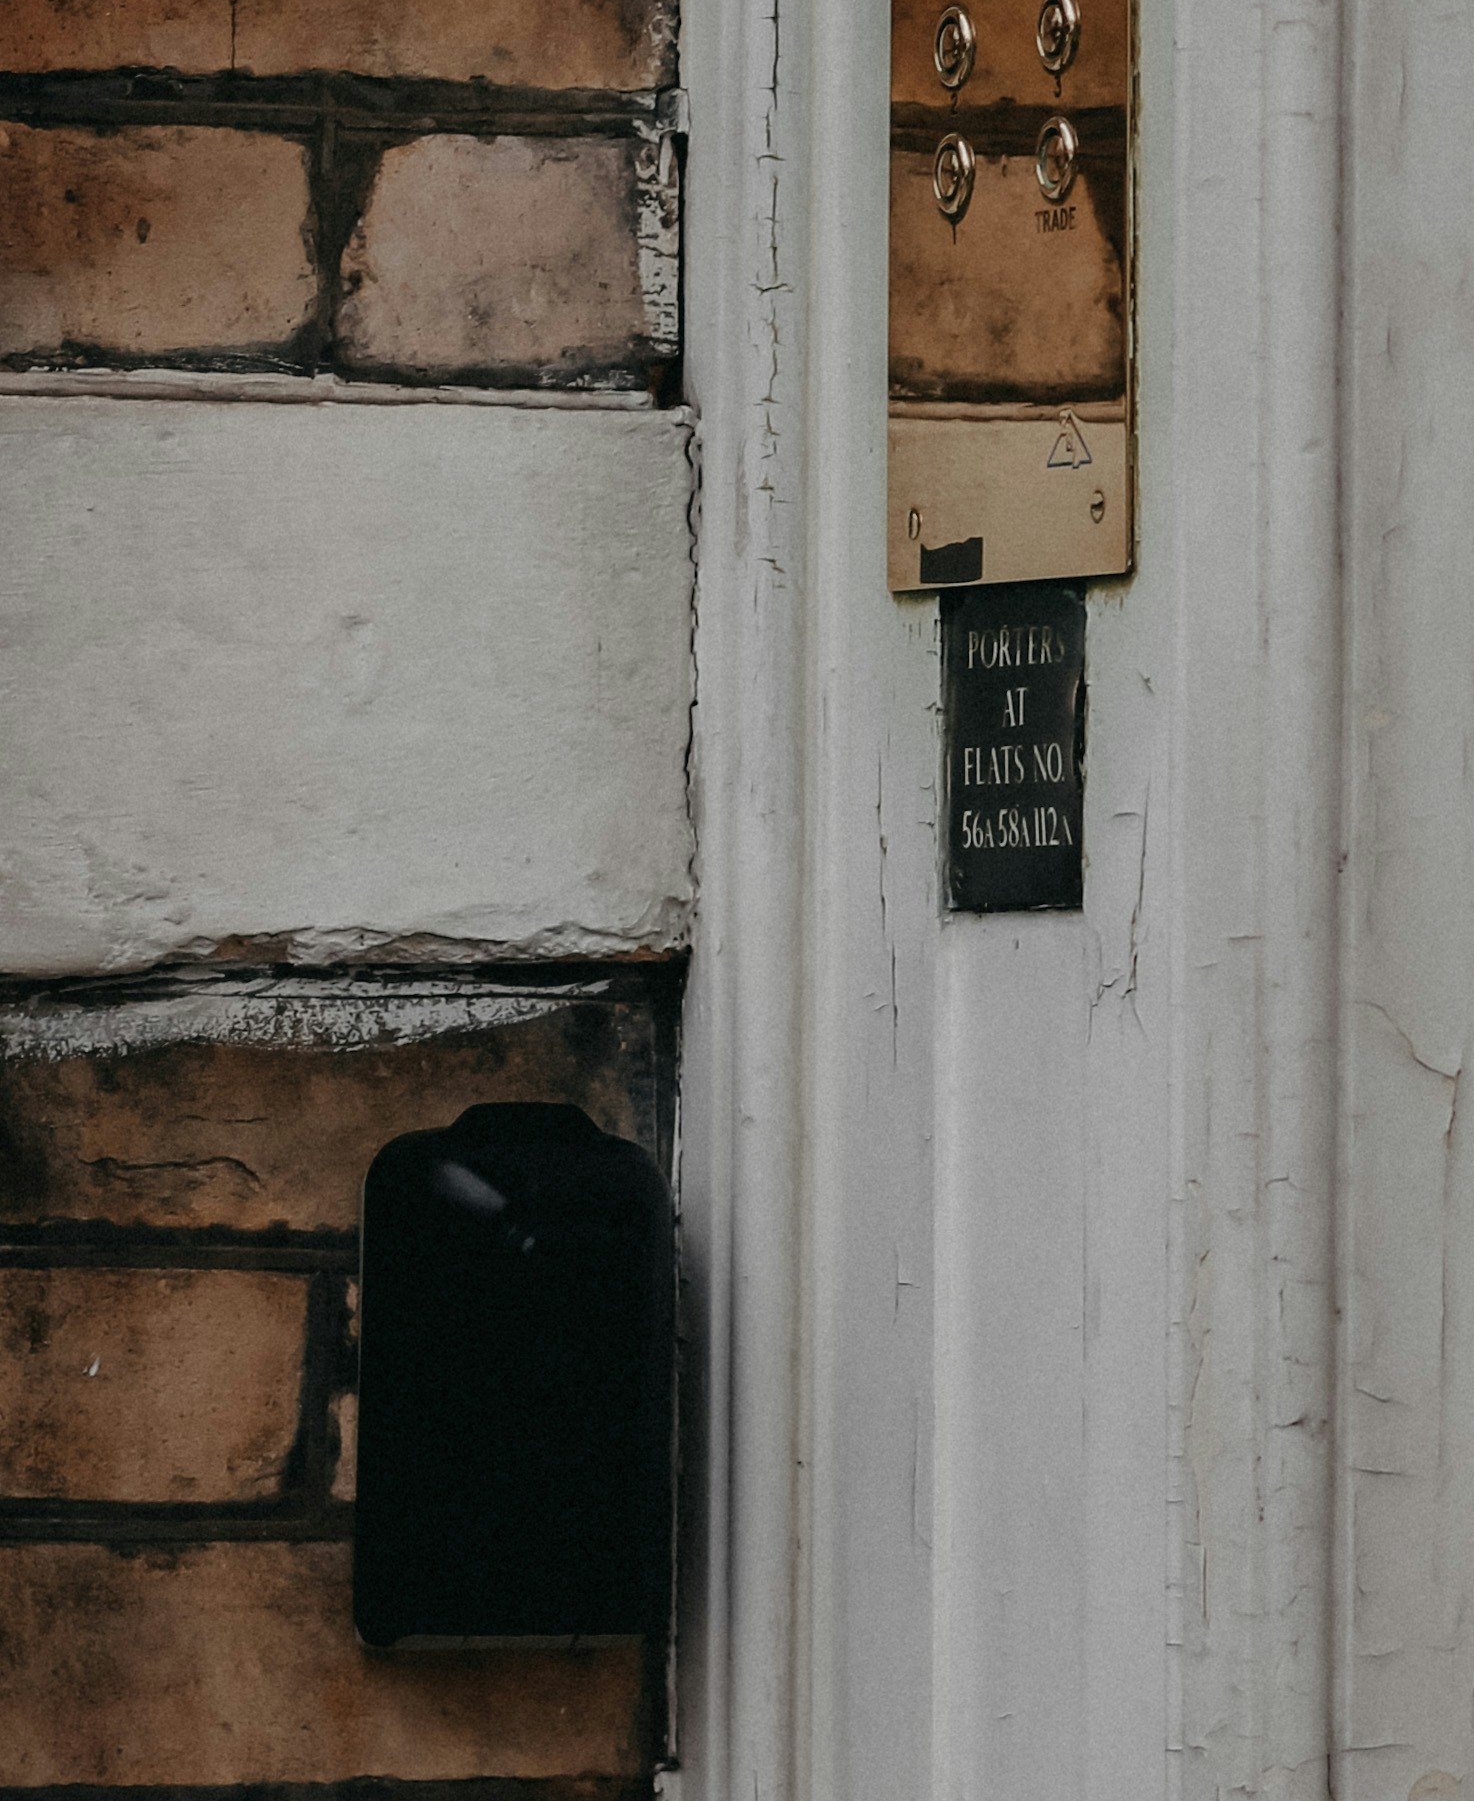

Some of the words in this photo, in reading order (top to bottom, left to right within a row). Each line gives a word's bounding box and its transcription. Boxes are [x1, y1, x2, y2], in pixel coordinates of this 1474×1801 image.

[951, 93, 959, 114] 2
[1053, 75, 1062, 98] 3
[1035, 207, 1077, 233] TRADE
[968, 626, 1065, 669] PORTERS
[1001, 687, 1028, 728] AT
[964, 745, 1025, 787] FLATS
[1033, 742, 1065, 784] NO.
[962, 810, 995, 849] 56A
[998, 808, 1029, 849] 58A
